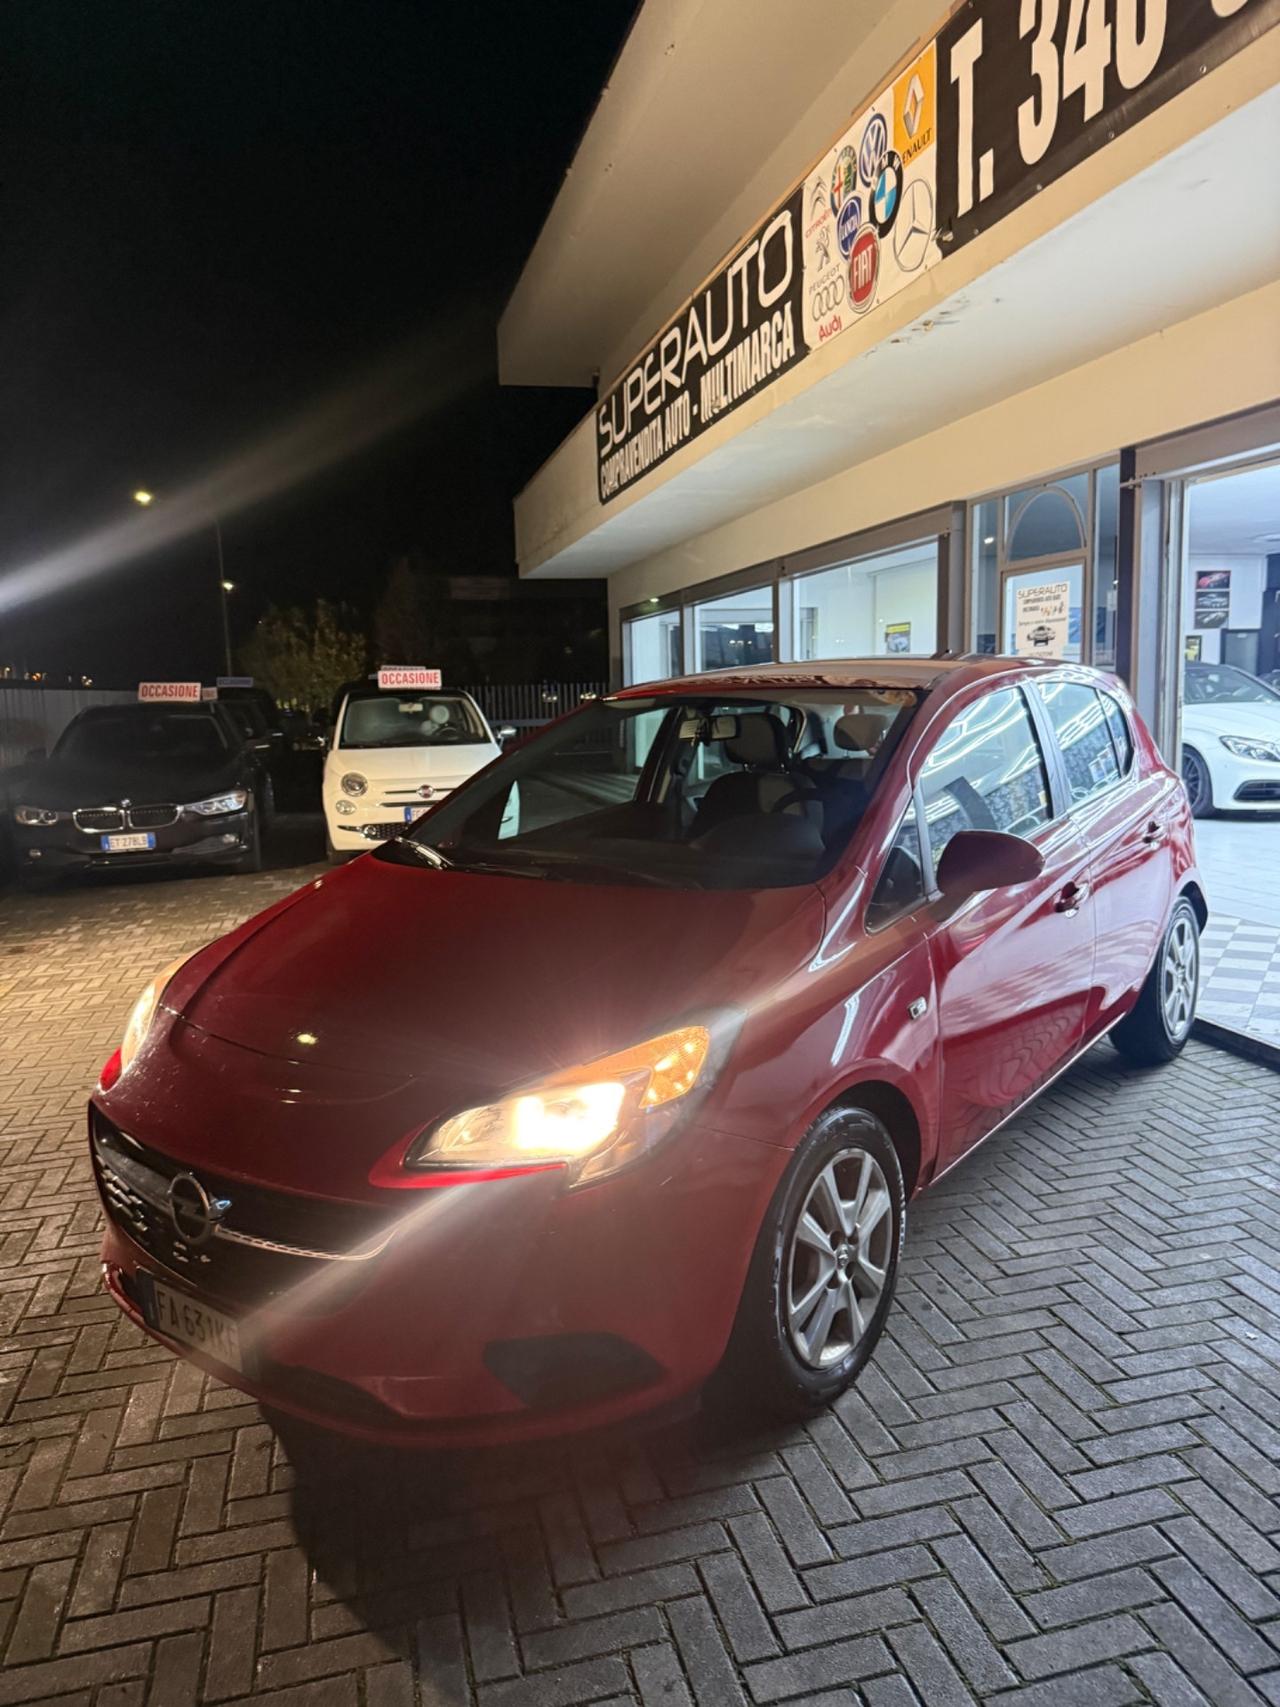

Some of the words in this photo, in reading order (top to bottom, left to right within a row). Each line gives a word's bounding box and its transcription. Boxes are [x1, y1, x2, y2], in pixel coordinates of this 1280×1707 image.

[951, 18, 993, 218] T.
[902, 128, 932, 164] ENAULT
[809, 263, 841, 295] PEUGEOT
[853, 244, 873, 292] FIAT
[599, 210, 793, 458] SUPERAUTO
[818, 314, 843, 341] Audi
[601, 415, 663, 499] COMPRAVENDITA
[665, 390, 690, 452] AUTO
[700, 301, 796, 424] MULTIMARCA
[1018, 583, 1067, 599] SUPERAUTO
[141, 685, 198, 698] OCCASIONE
[382, 672, 439, 684] OCCASIONE
